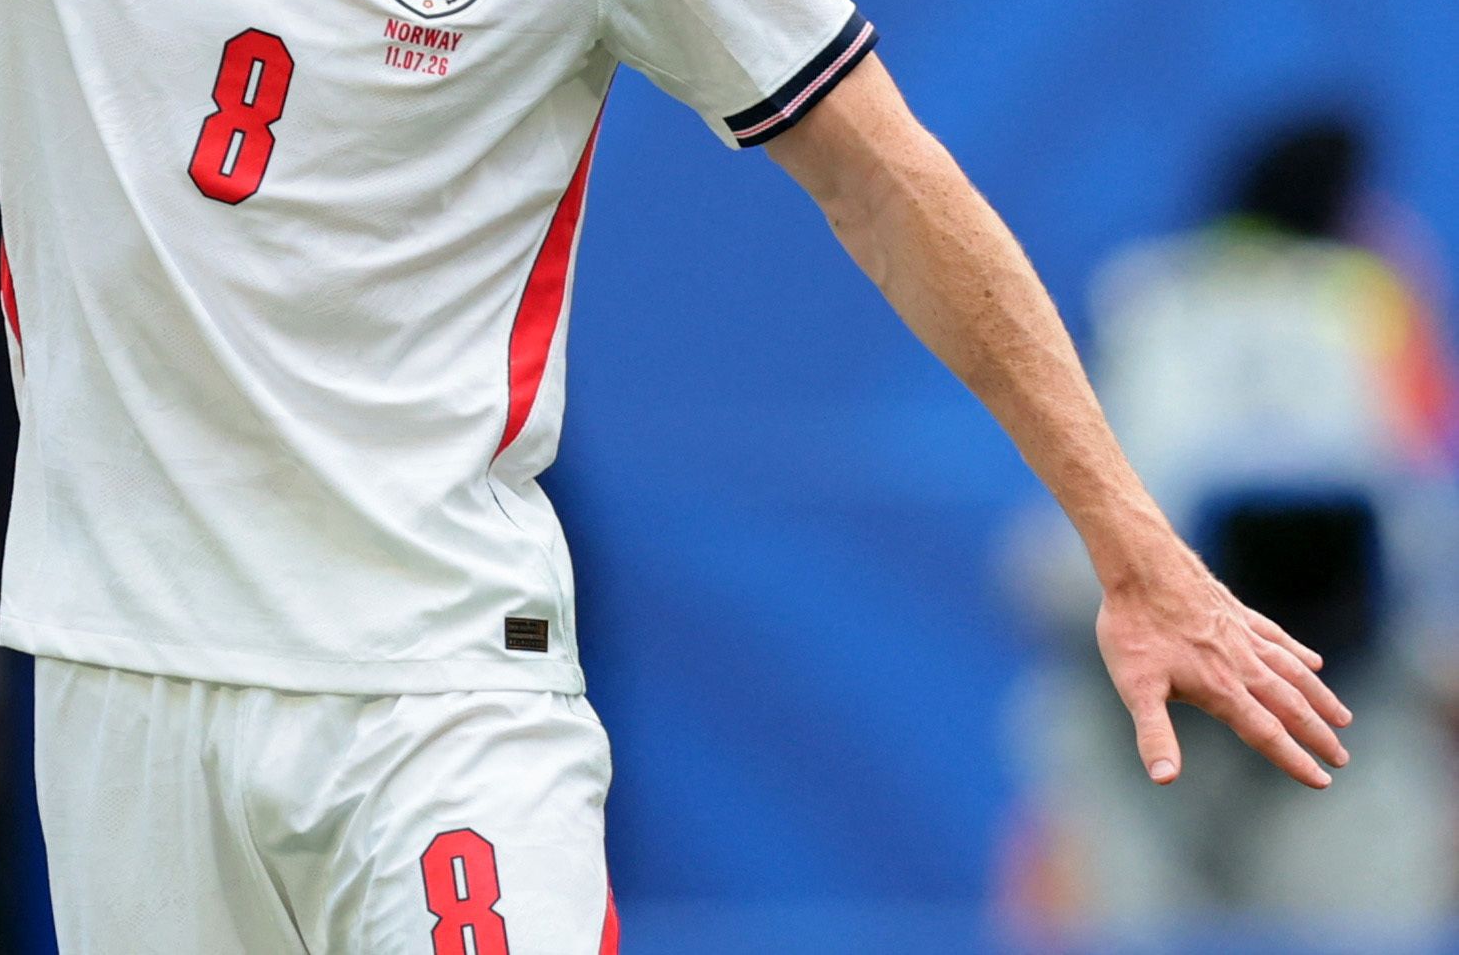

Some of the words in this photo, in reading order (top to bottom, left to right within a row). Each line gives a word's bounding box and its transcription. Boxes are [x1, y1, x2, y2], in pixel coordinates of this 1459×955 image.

[384, 18, 463, 51] NORWAY
[385, 45, 449, 76] 11.07.26
[187, 27, 295, 206] 8
[420, 827, 510, 955] 8
